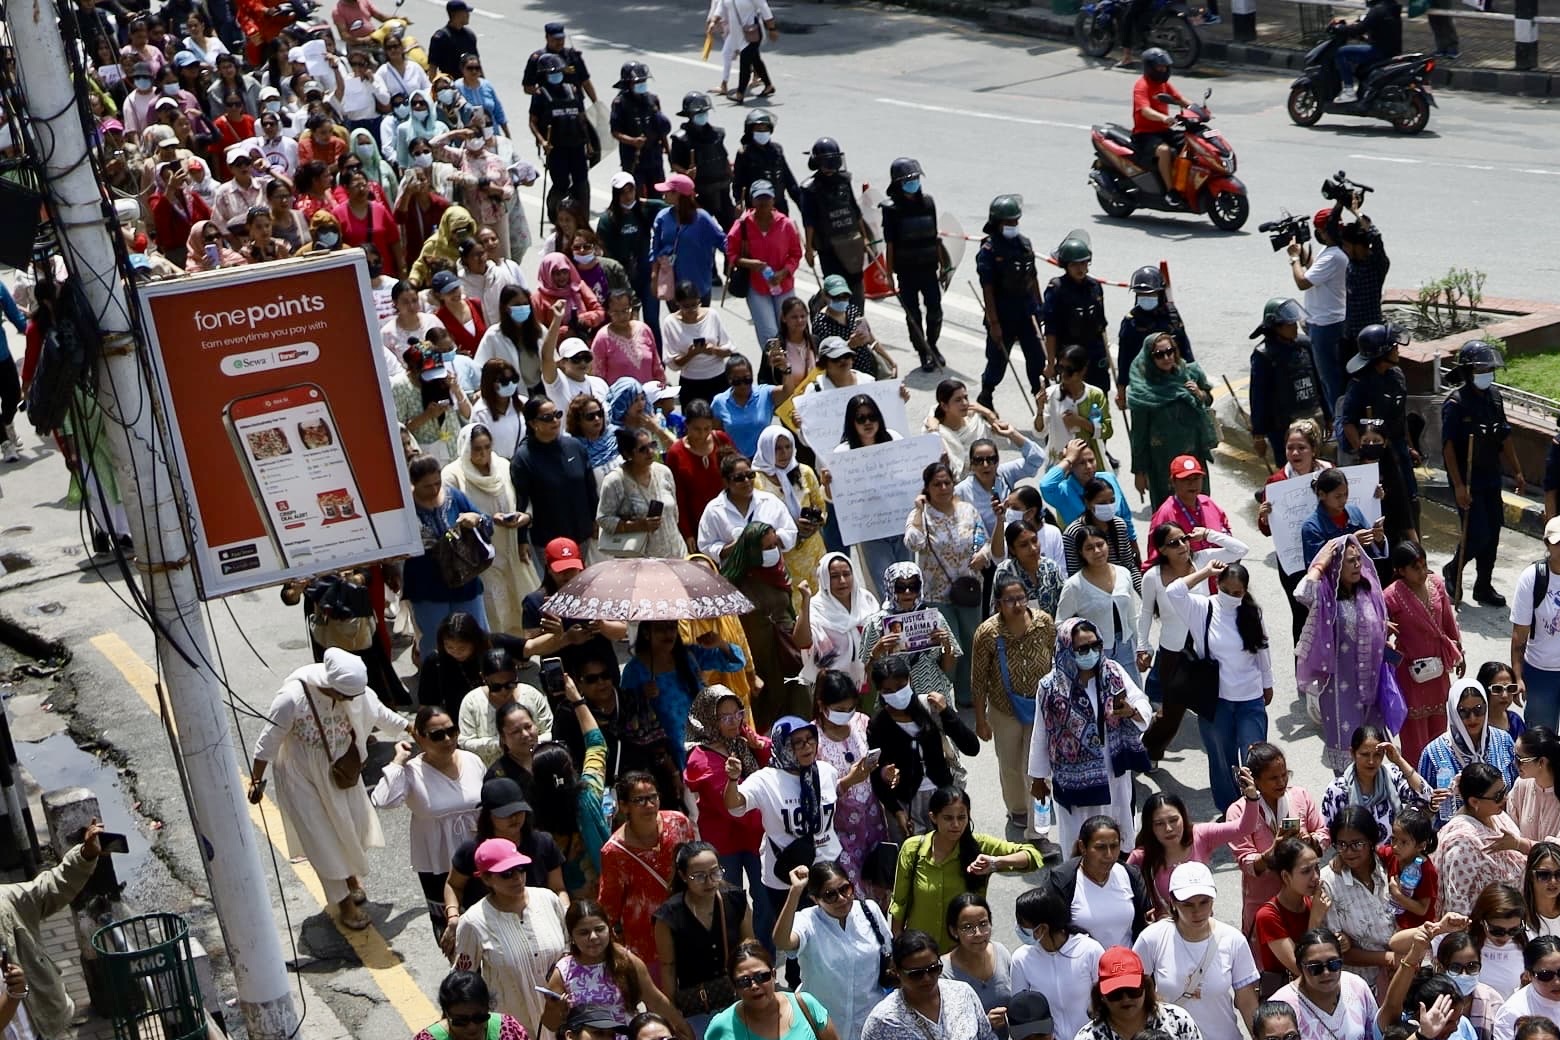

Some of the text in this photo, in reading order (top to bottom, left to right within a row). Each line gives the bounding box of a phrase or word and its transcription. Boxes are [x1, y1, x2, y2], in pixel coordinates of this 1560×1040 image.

[201, 319, 328, 350] Earn everytime you pay with
[901, 612, 925, 625] JUSTICE
[129, 952, 166, 973] KMC
